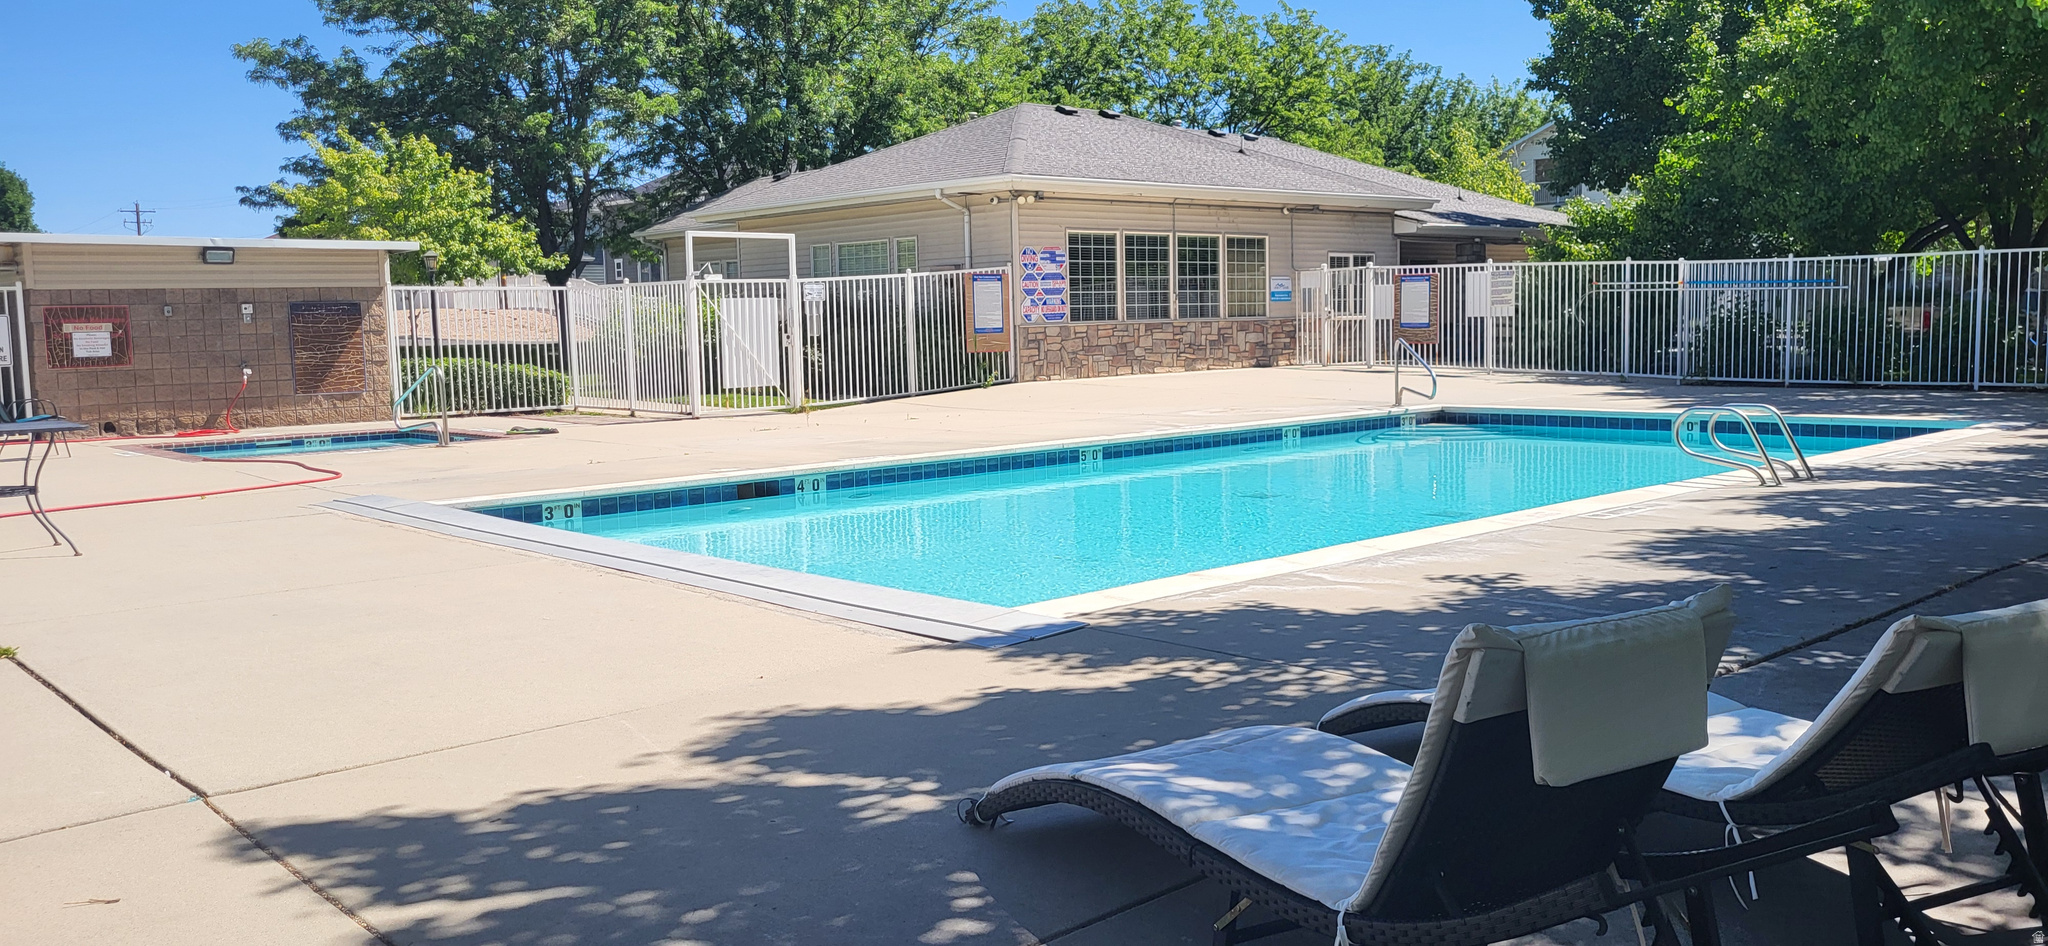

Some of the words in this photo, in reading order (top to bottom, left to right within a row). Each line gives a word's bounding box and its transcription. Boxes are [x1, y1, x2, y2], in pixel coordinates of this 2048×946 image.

[1402, 417, 1405, 426] 3
[1409, 416, 1412, 425] 0
[1687, 422, 1693, 431] 0
[1284, 430, 1288, 439] 4
[1292, 428, 1296, 438] 0
[1081, 450, 1086, 461] 5
[1092, 450, 1098, 460] 0
[797, 480, 805, 492] 4
[812, 479, 820, 491] 0
[545, 507, 554, 520] 3
[564, 504, 573, 518] 0
